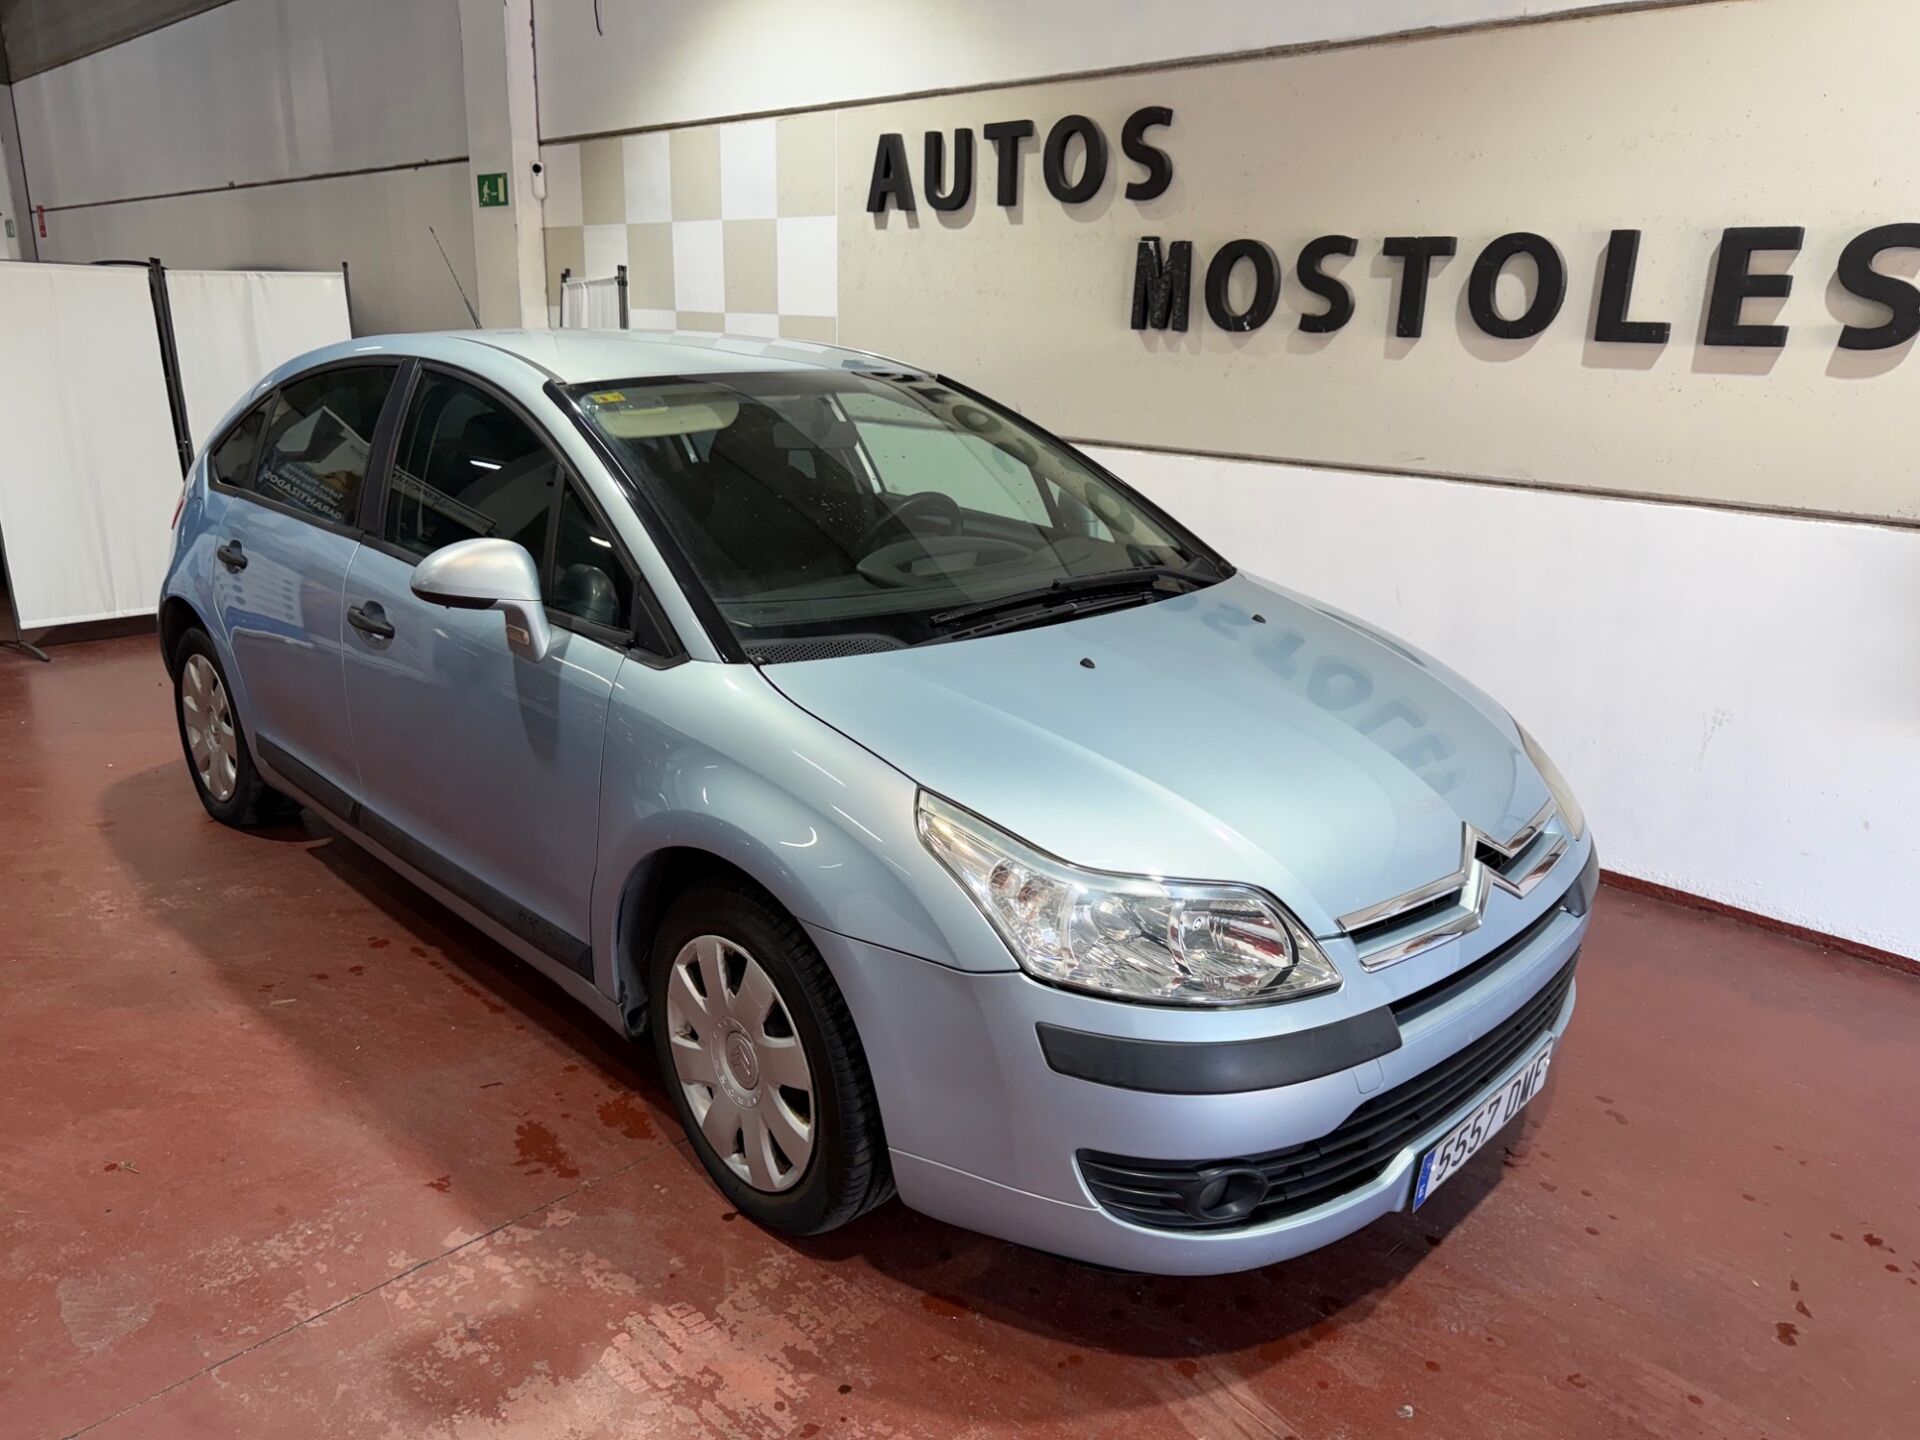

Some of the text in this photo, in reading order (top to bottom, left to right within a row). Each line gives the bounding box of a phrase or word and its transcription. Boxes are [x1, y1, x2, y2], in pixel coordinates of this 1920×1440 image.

[866, 106, 1173, 212] AUTOS
[1131, 223, 1920, 350] MOSTOLES
[1436, 1096, 1503, 1182] 5557
